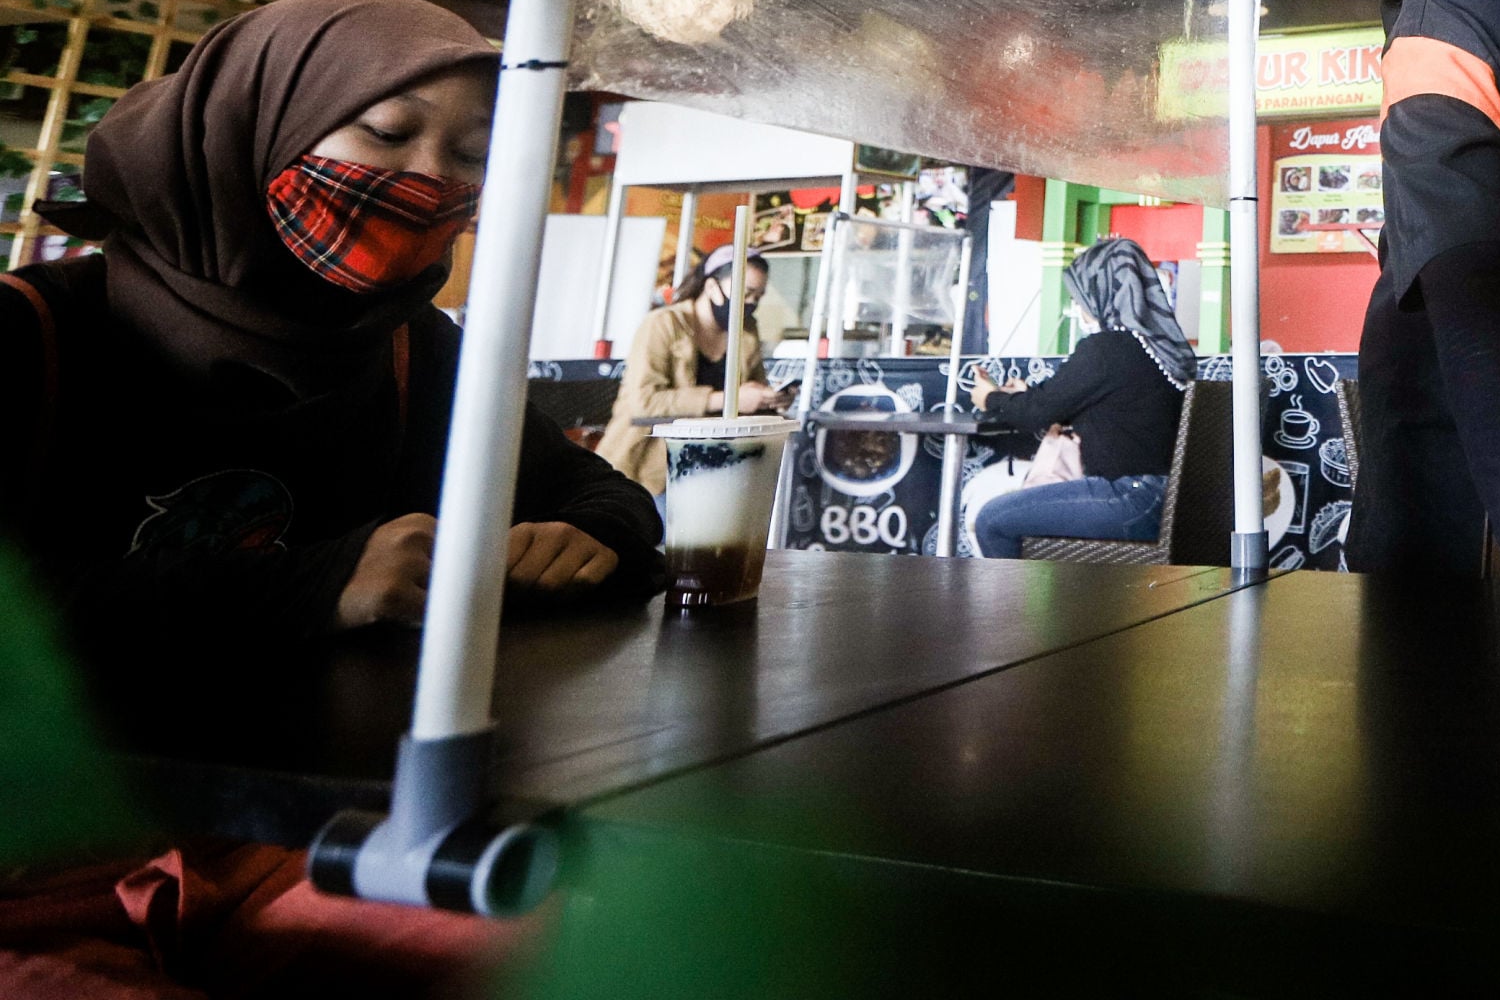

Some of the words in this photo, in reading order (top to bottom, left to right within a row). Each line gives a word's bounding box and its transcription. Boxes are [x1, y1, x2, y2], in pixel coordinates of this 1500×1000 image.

[1264, 92, 1364, 109] PARAHYANGAN
[1289, 126, 1340, 150] Dapur
[820, 505, 907, 548] BBQ
